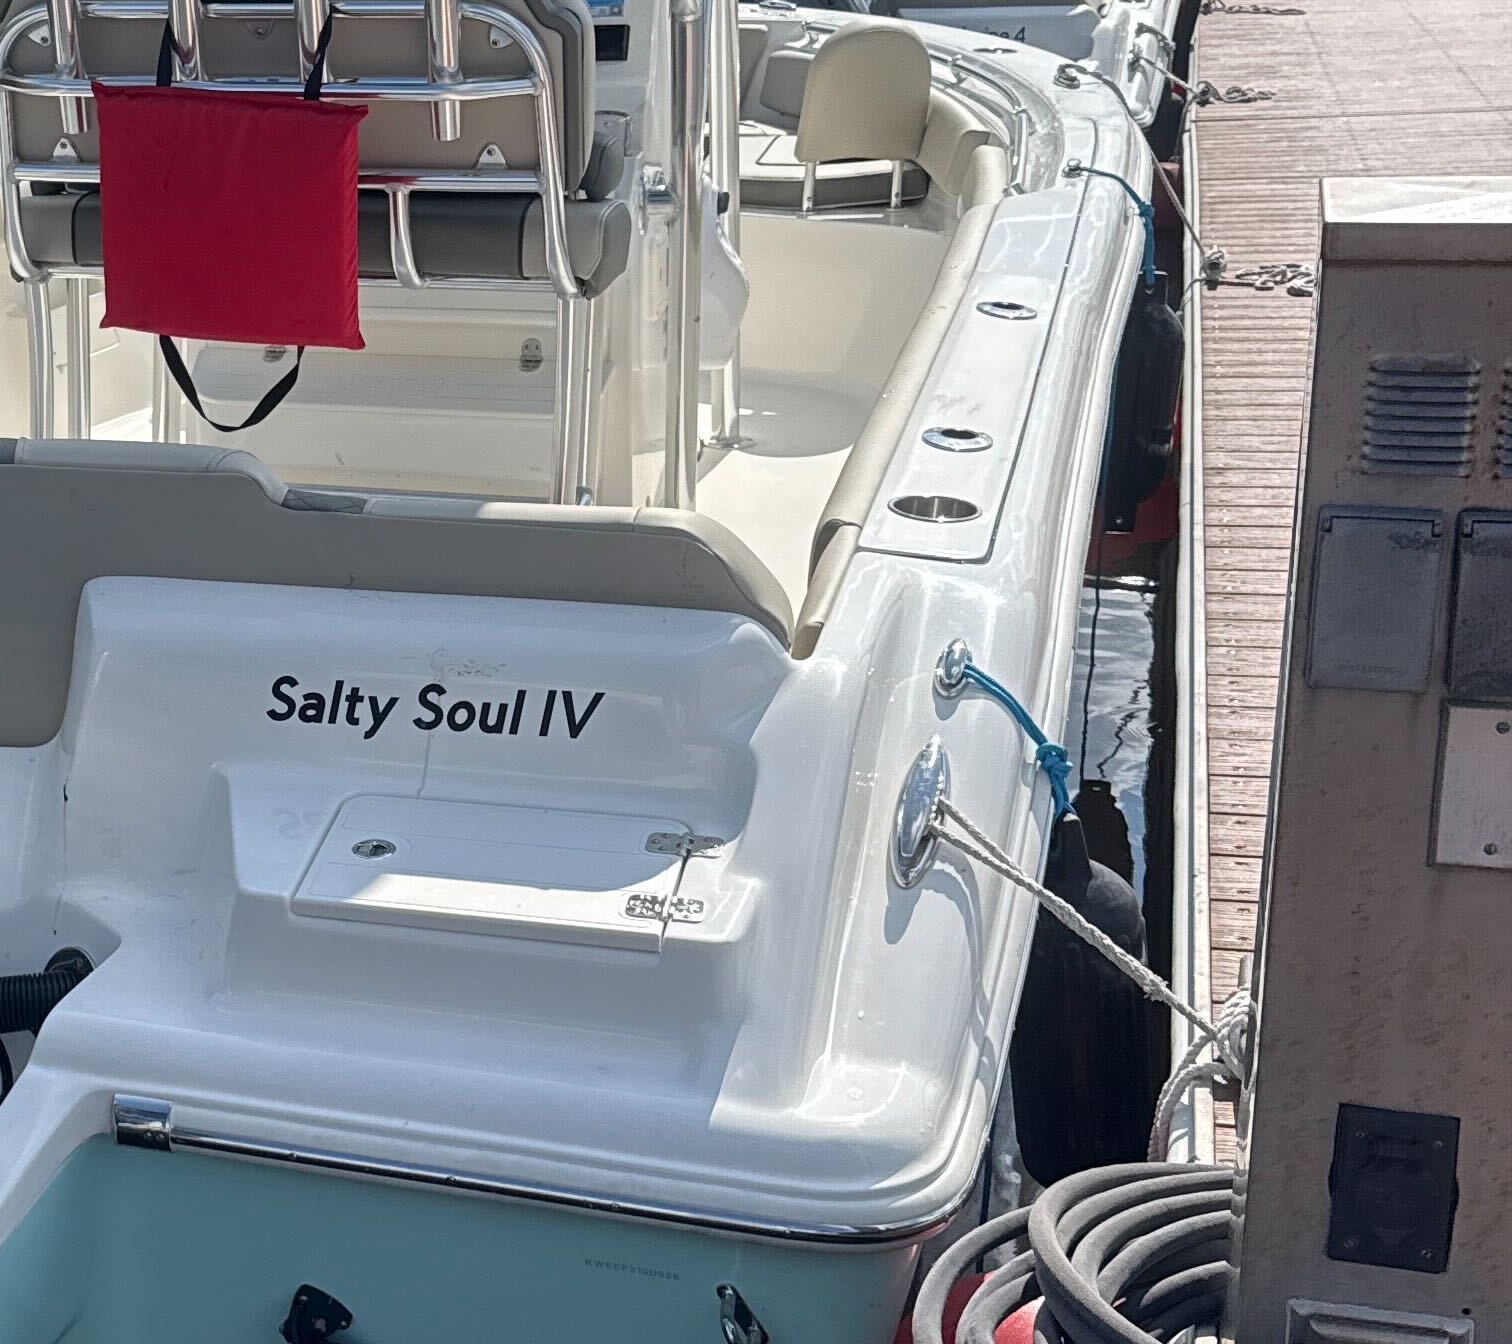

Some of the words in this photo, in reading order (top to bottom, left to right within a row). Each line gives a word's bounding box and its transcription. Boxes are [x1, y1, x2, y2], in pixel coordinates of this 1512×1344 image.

[266, 675, 400, 740] Salty
[412, 683, 527, 736] Soul
[538, 690, 606, 739] IV
